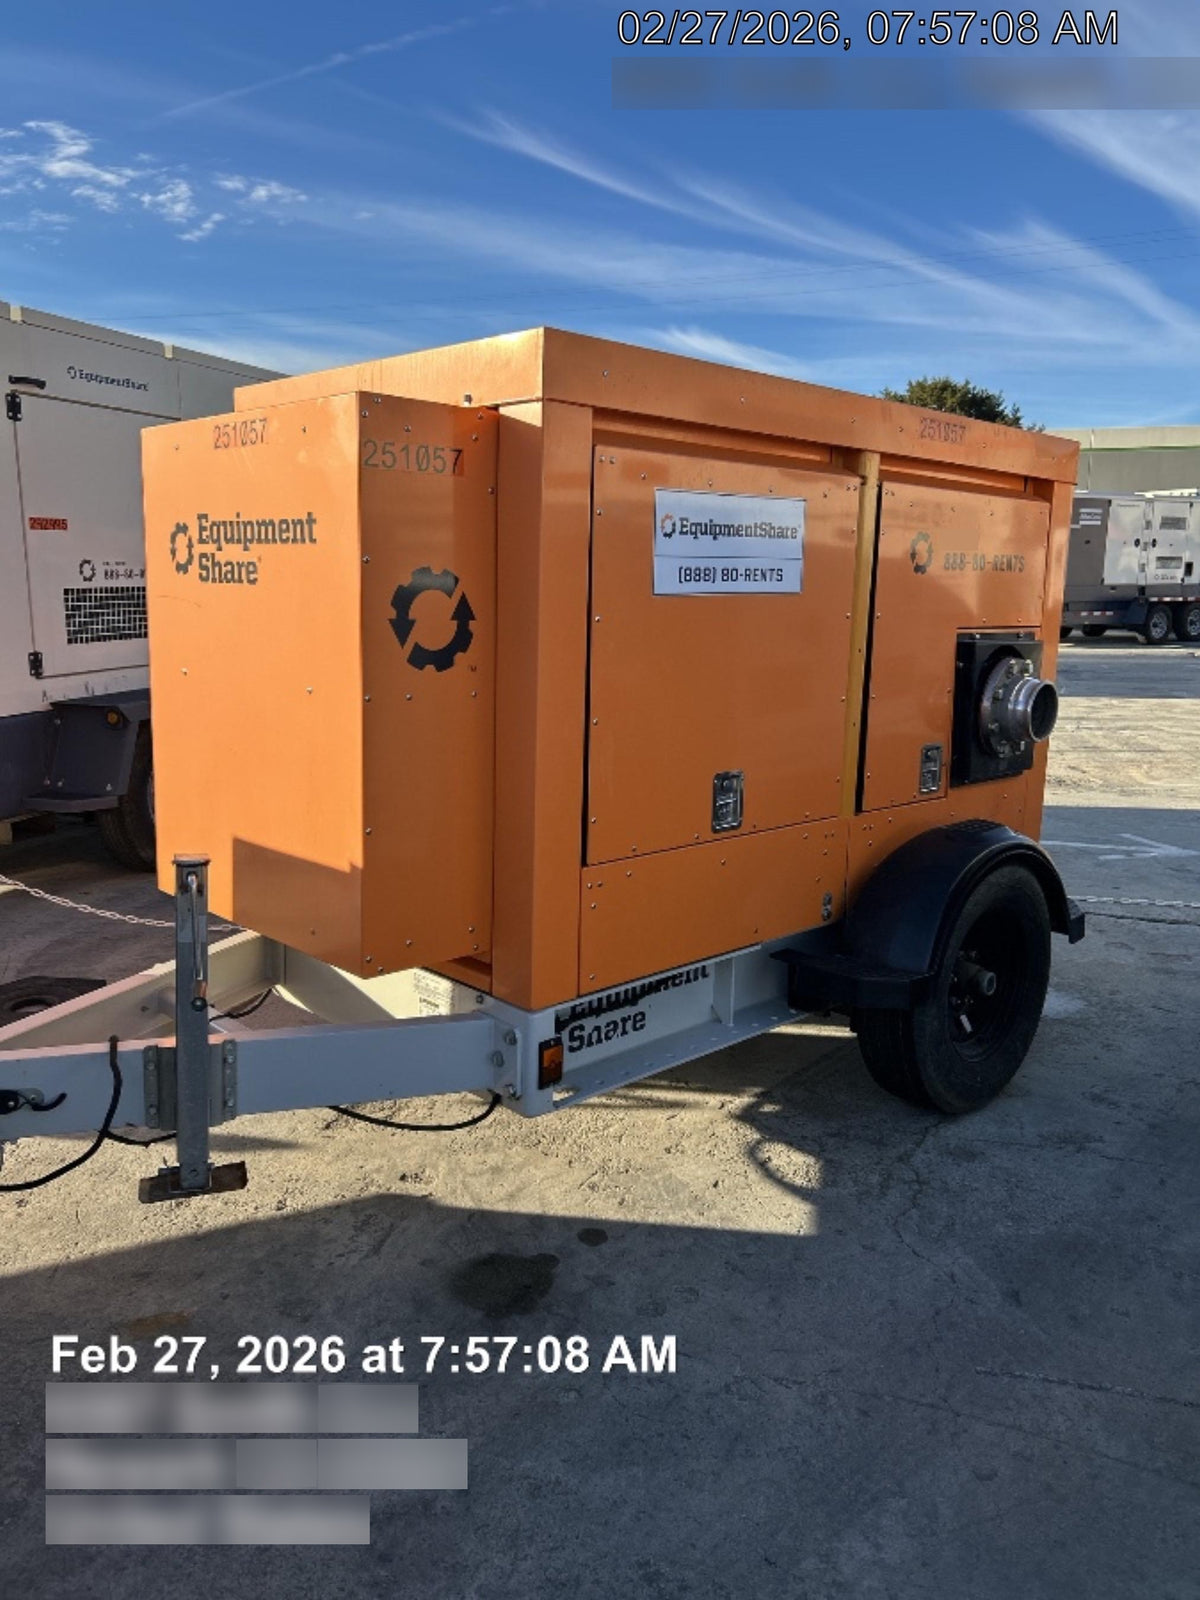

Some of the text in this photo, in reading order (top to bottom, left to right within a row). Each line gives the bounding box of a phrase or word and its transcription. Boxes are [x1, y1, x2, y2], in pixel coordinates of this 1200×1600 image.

[214, 418, 268, 449] 251057
[363, 439, 463, 475] 251057
[197, 511, 317, 551] Equipment
[678, 517, 797, 540] EquipmentShare
[198, 552, 258, 585] Share
[678, 566, 784, 583] (888) 80-RENTS
[943, 552, 1025, 573] 888-80-RENTS
